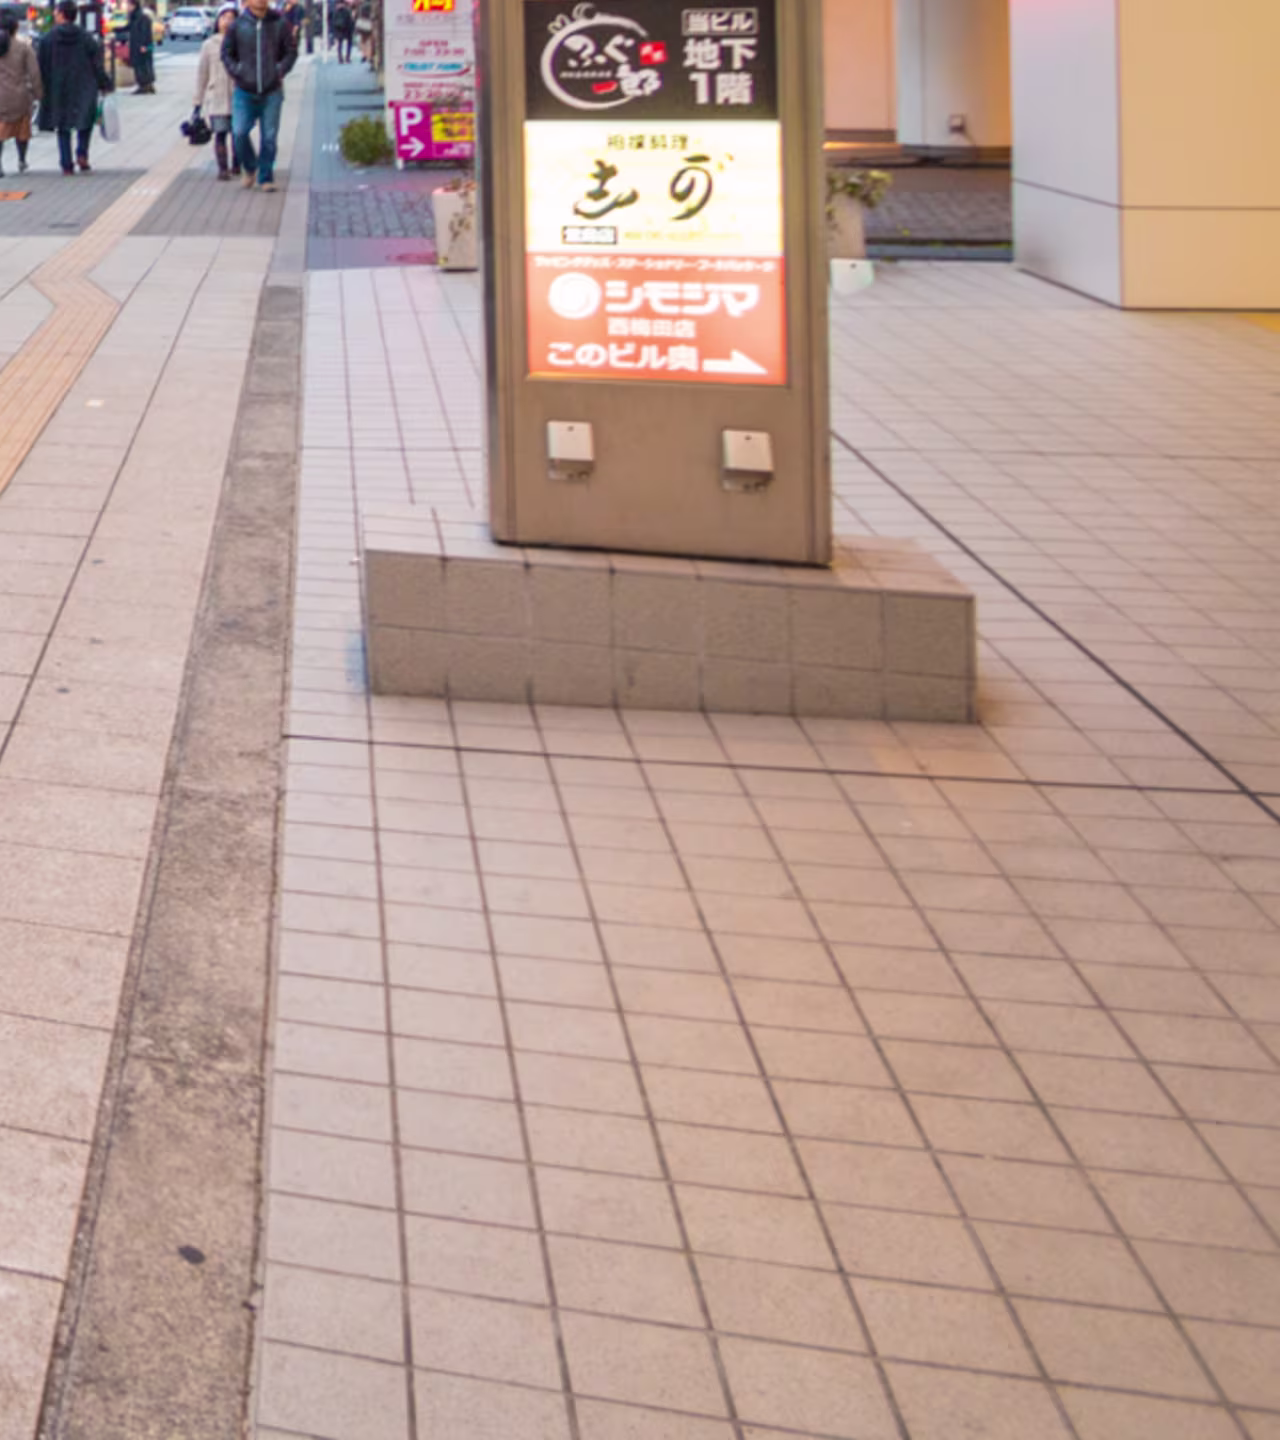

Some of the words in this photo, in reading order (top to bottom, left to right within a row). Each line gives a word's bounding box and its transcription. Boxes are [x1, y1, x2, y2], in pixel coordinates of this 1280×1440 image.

[683, 39, 757, 70] 地下
[689, 72, 753, 105] 1階
[400, 106, 423, 136] P
[605, 279, 760, 317] シモジマ
[607, 317, 696, 339] 西梅田店
[547, 341, 698, 371] このビル奥
